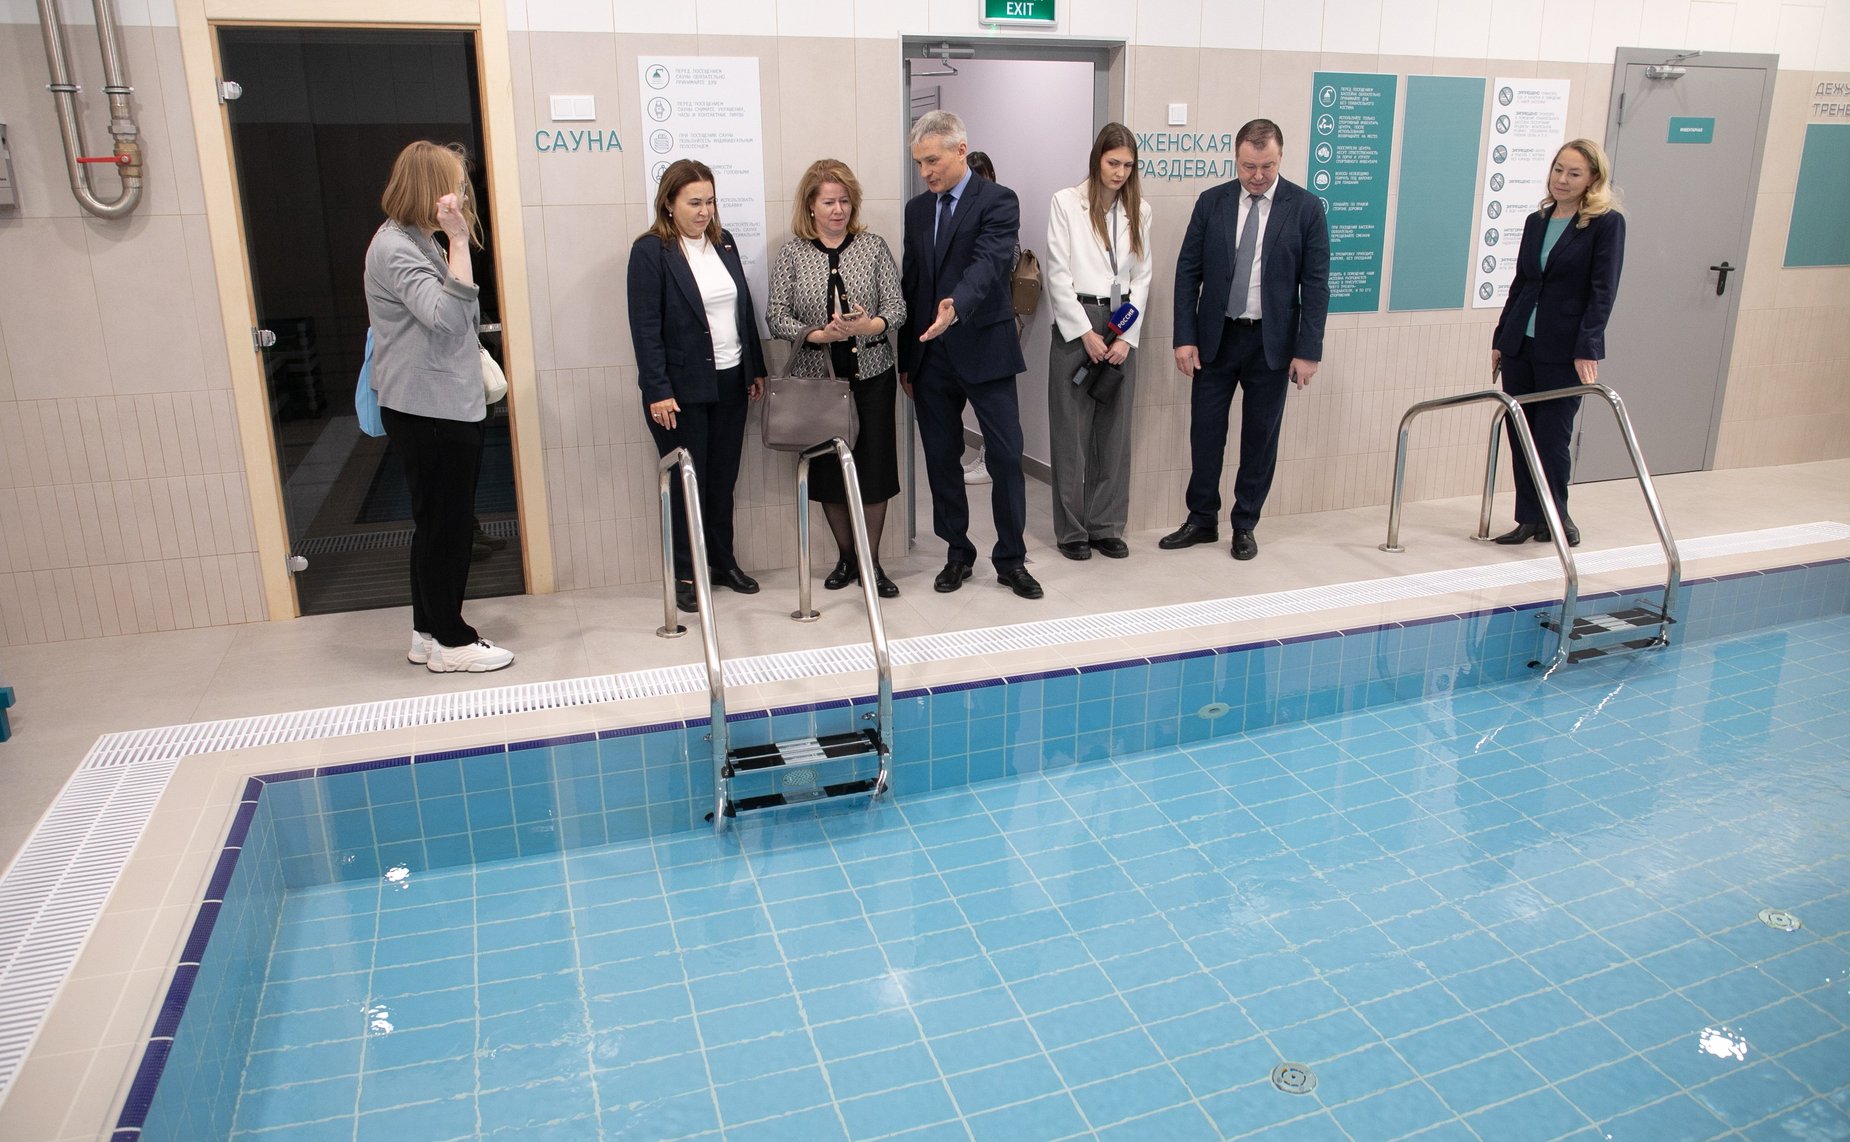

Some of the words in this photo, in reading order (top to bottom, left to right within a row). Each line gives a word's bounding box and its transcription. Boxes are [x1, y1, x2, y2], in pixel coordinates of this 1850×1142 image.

[1006, 2, 1034, 16] EXIT
[1814, 103, 1850, 116] ТРЕНЕ
[536, 130, 622, 151] САУНА
[1136, 133, 1232, 152] ЖЕНСКАЯ
[1118, 308, 1134, 329] РОССИЯ
